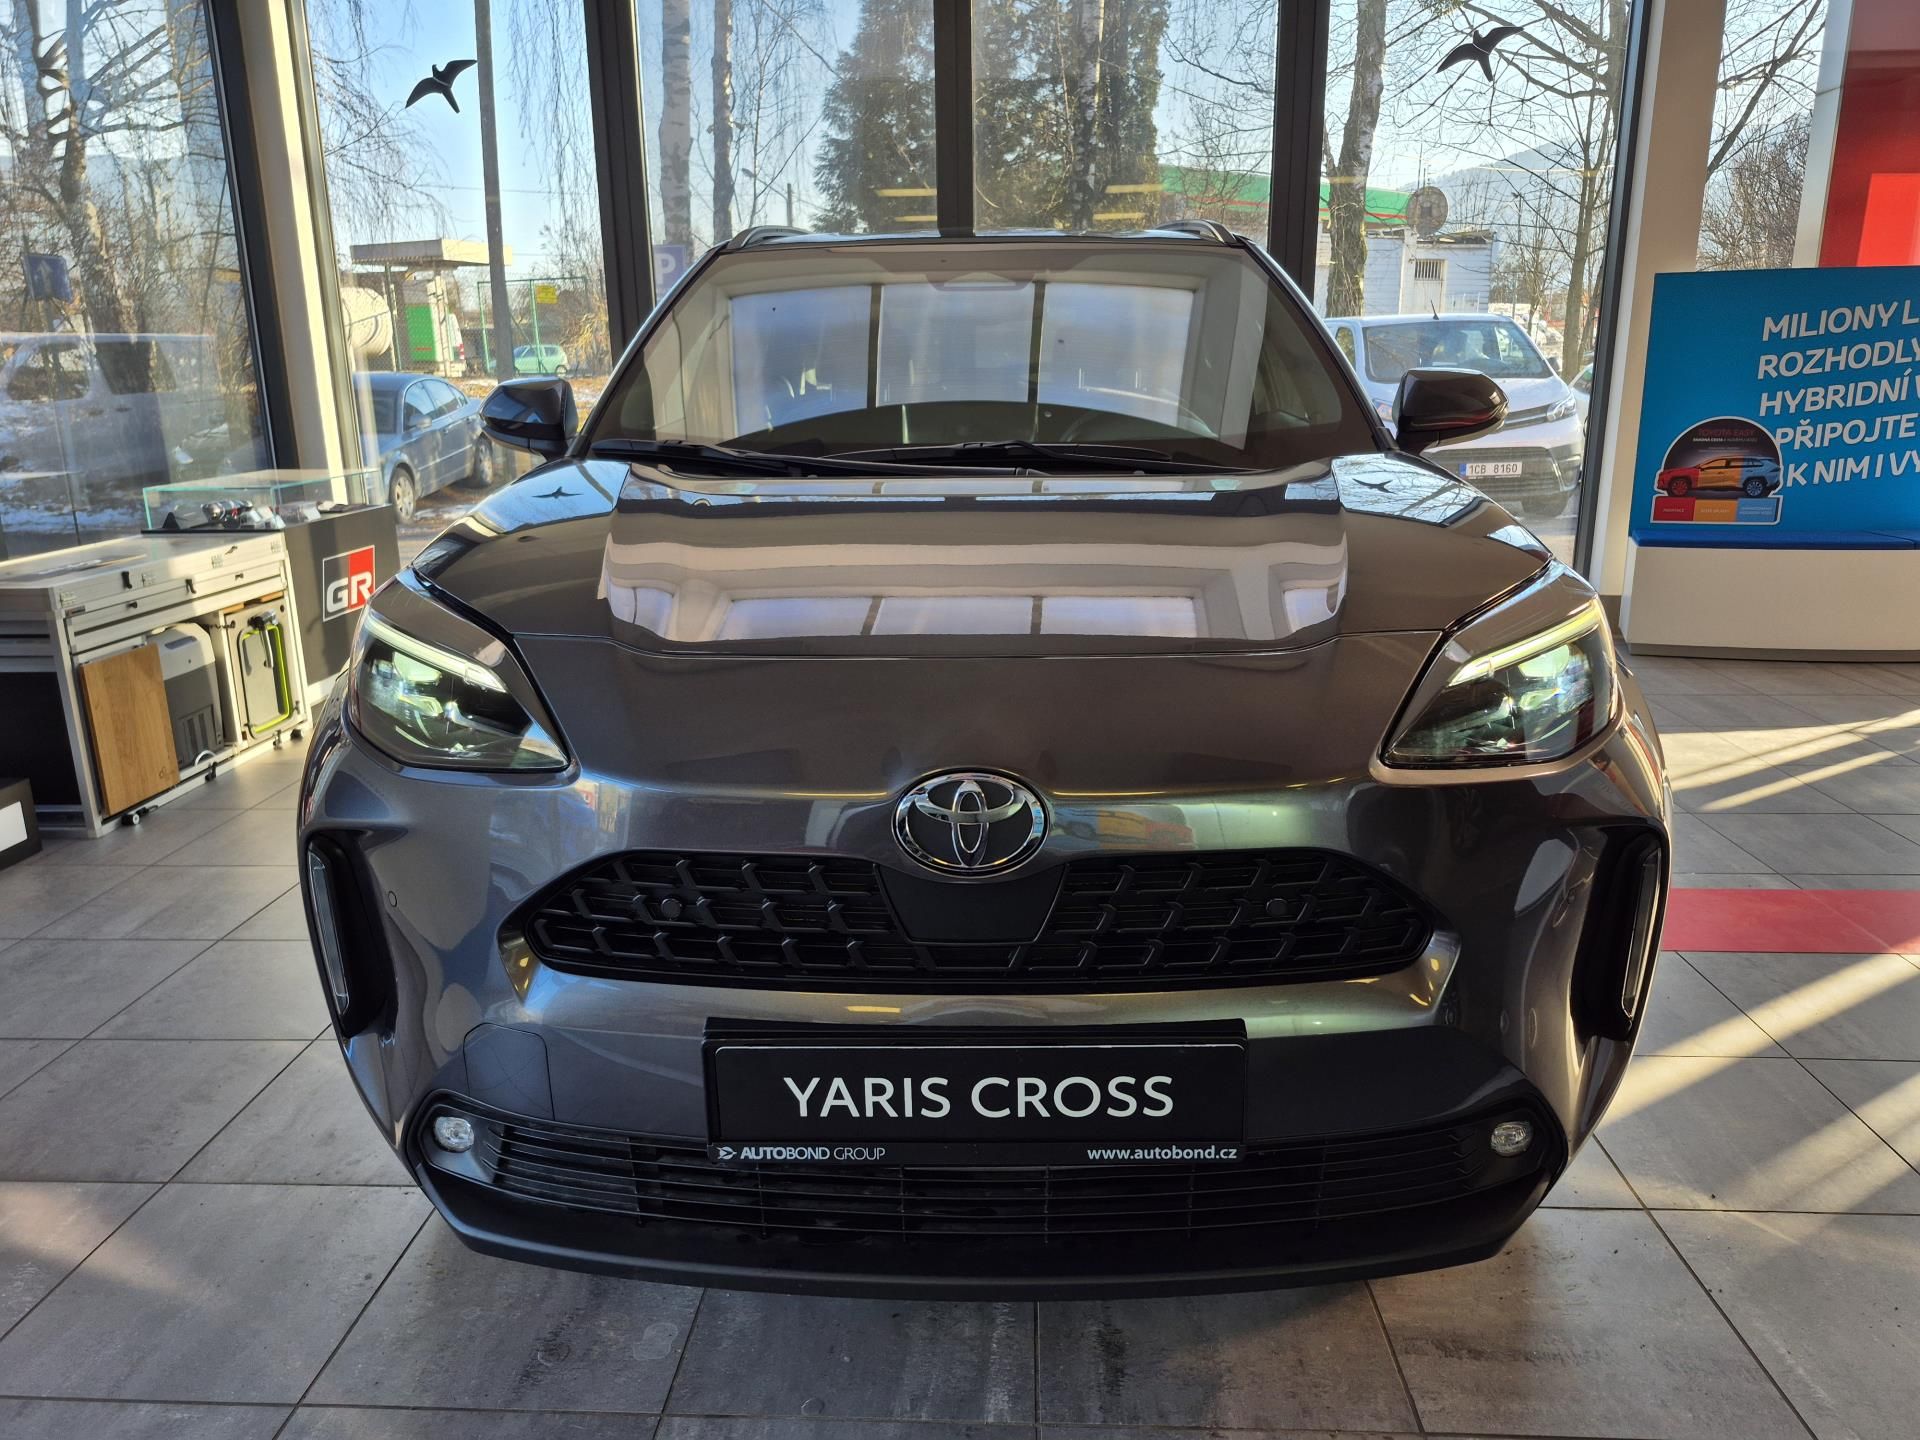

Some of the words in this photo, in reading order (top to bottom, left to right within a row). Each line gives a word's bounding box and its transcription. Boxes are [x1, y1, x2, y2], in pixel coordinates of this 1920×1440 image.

[1762, 301, 1899, 342] MILIONY
[1902, 299, 1920, 325] L
[1759, 367, 1913, 417] HYBRIDNÍ
[1775, 412, 1919, 450] PŘIPOJTE
[1468, 464, 1487, 475] 1CB
[1493, 463, 1518, 474] 8160
[1786, 462, 1809, 487] K
[1812, 455, 1871, 485] NIM
[1875, 453, 1884, 478] I
[326, 571, 373, 613] GR
[783, 1076, 951, 1119] YARIS
[970, 1075, 1174, 1119] CROSS
[740, 1146, 830, 1161] AUTOBOND
[833, 1147, 886, 1161] GROUP
[1087, 1145, 1237, 1160] www.autobond.cz
